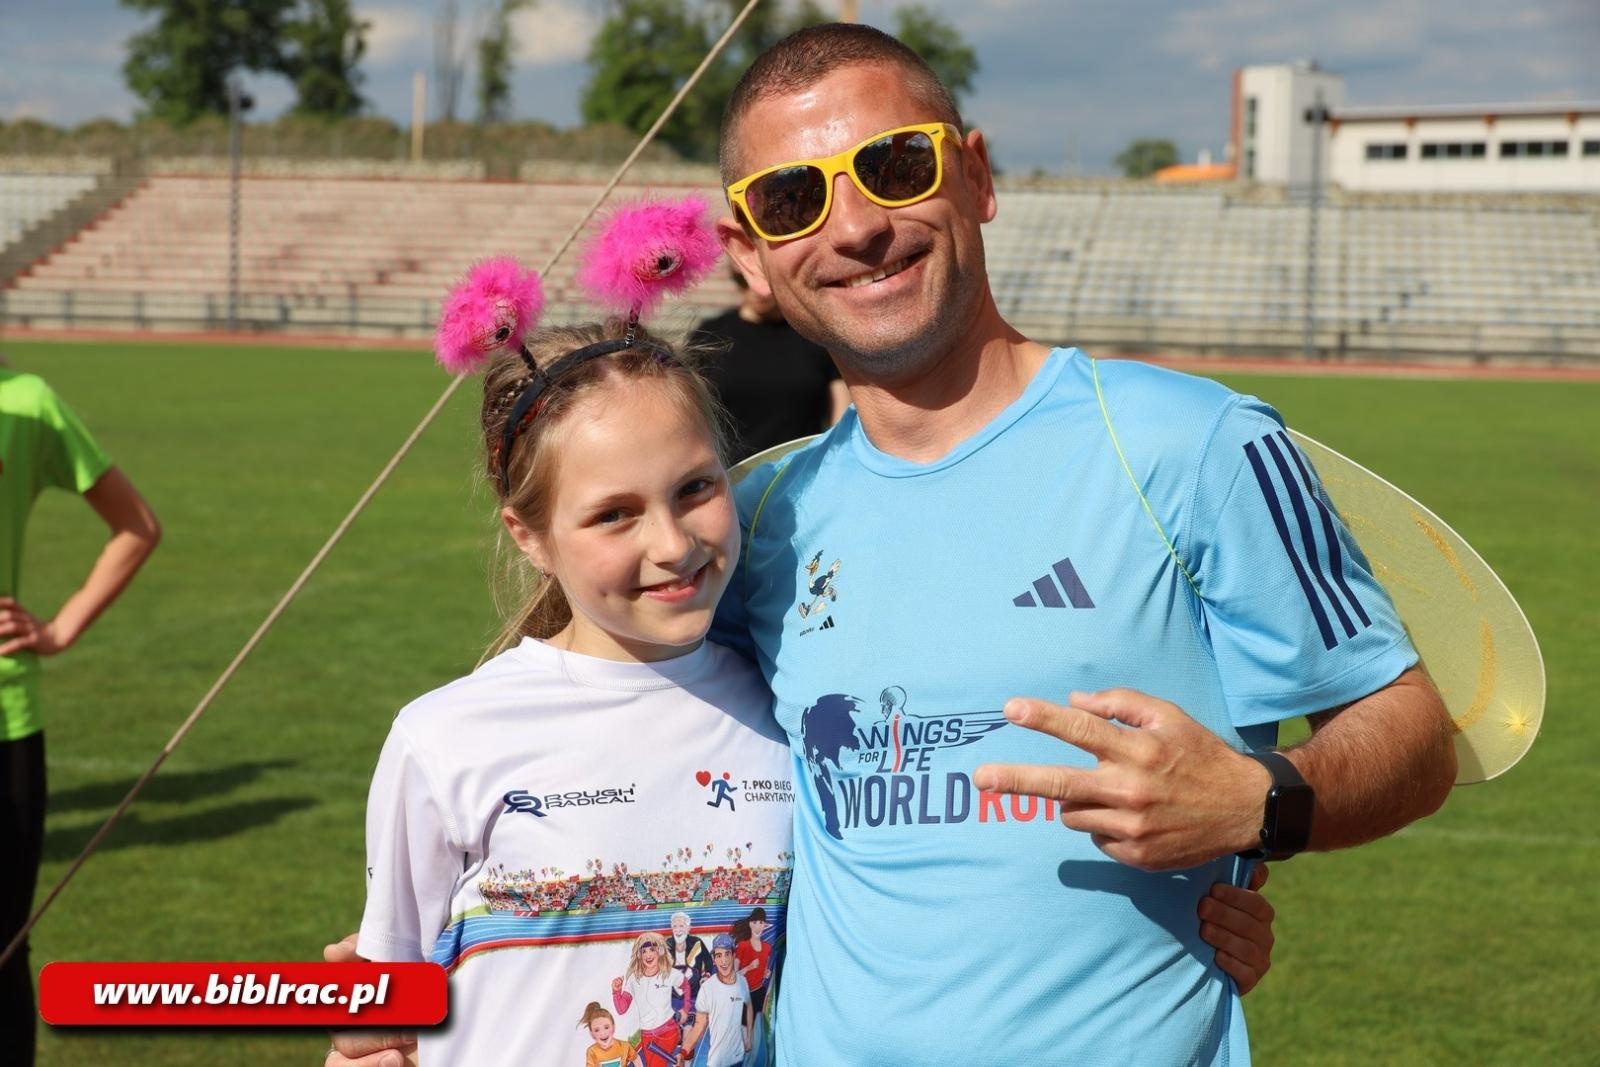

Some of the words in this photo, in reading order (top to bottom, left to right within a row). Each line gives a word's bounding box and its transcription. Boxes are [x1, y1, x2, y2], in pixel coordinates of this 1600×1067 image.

[858, 718, 963, 750] WINGS
[858, 751, 880, 764] FOR
[876, 746, 936, 773] LIFE
[544, 787, 634, 803] ROUGH
[742, 780, 752, 790] 7.
[752, 780, 773, 791] PKO
[774, 780, 792, 792] BIEG
[545, 795, 636, 810] RADICAL
[838, 772, 971, 829] WORLD
